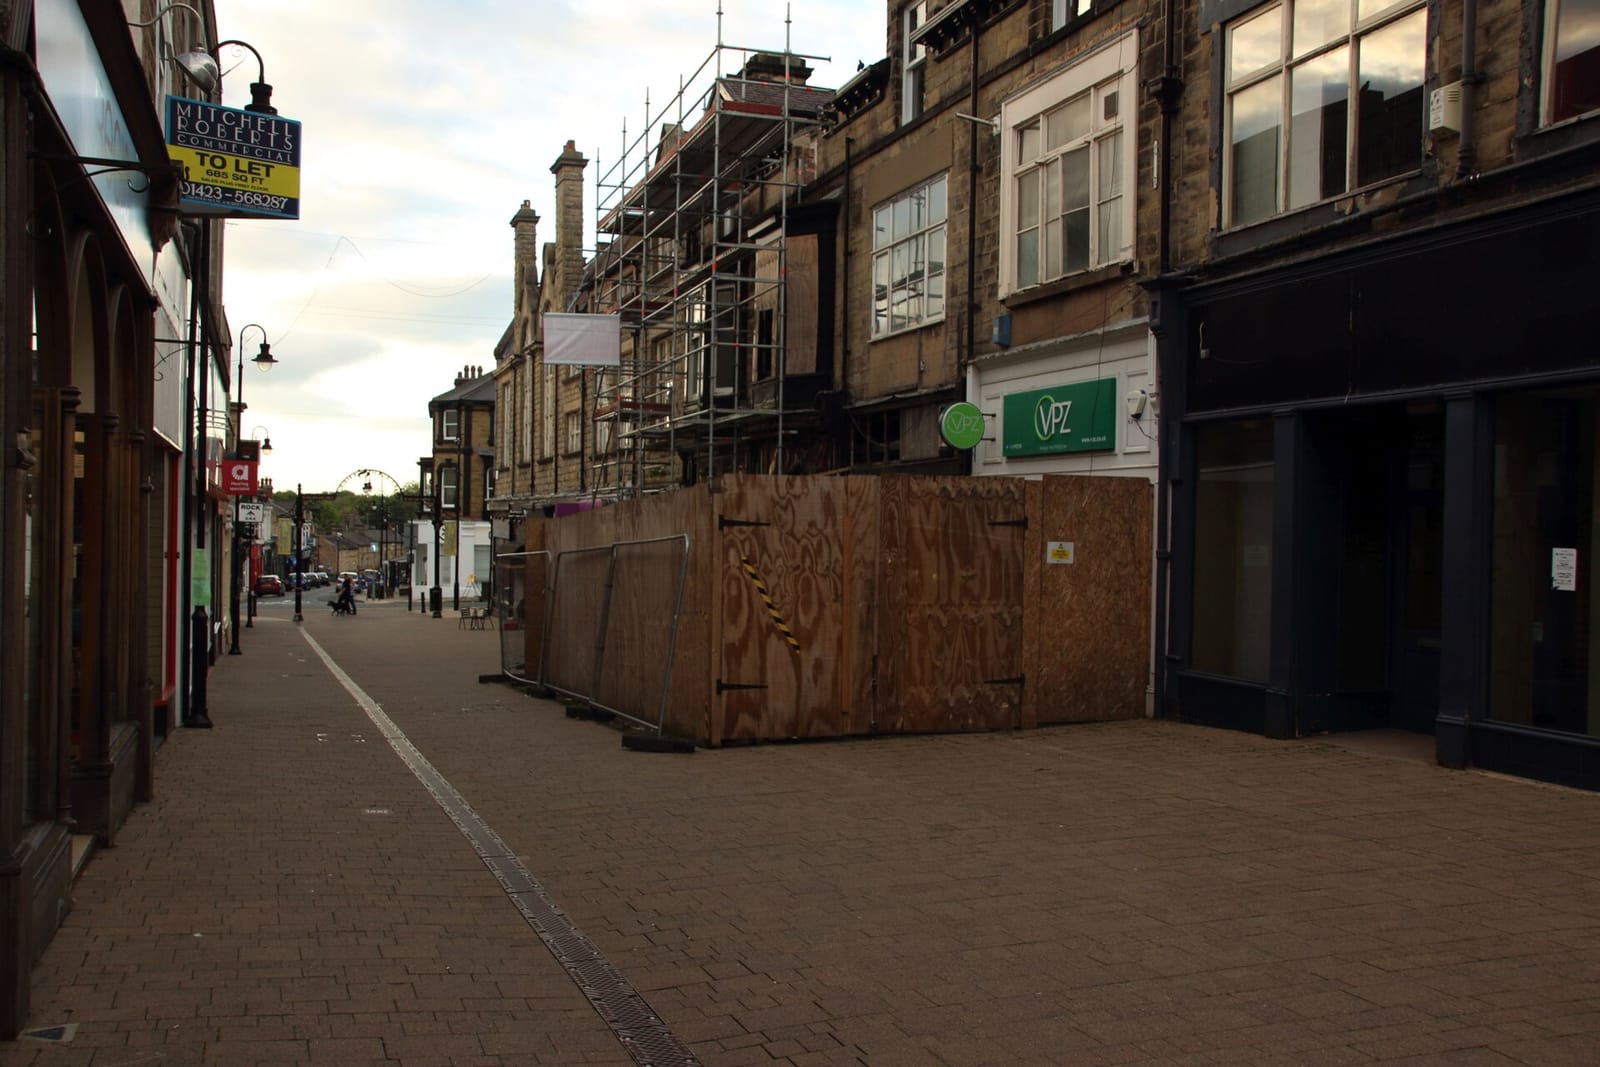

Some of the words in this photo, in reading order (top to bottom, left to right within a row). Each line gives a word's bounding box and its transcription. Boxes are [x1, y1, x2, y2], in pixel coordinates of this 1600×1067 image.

[177, 103, 289, 136] MITCHELL
[177, 115, 293, 151] ROBERTS
[177, 135, 292, 162] COMMERCIAL
[195, 151, 227, 169] TO
[234, 159, 275, 178] LET
[205, 169, 229, 180] 685
[231, 172, 249, 184] SQ
[251, 176, 265, 185] FT
[949, 413, 980, 432] VPZ
[1038, 400, 1072, 436] VPZ
